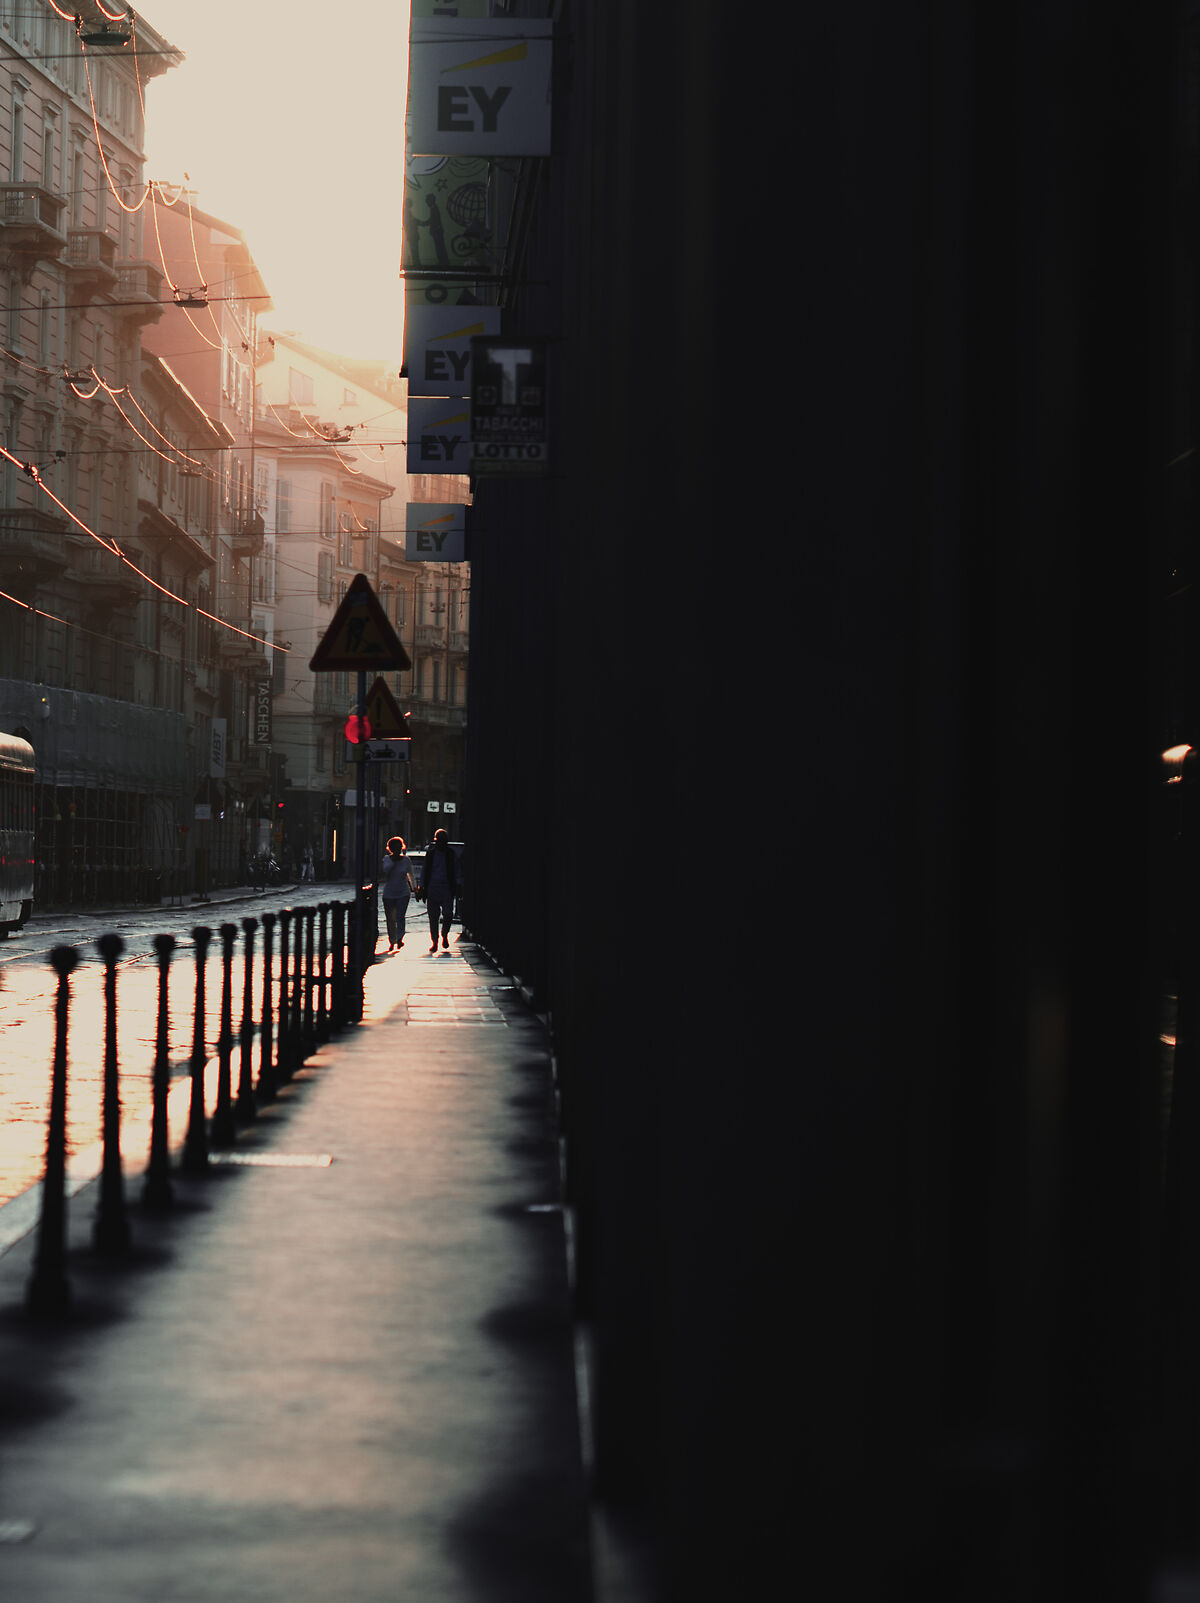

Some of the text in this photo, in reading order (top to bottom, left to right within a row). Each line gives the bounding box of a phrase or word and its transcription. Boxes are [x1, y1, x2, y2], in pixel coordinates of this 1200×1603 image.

[437, 86, 513, 132] EY
[424, 350, 472, 381] EY
[487, 348, 533, 406] T
[474, 416, 544, 432] TABACCHI
[420, 435, 463, 461] EY
[474, 444, 541, 459] LOTTO
[417, 531, 449, 553] EY
[257, 680, 270, 742] TASCHEN
[212, 728, 222, 767] MBT
